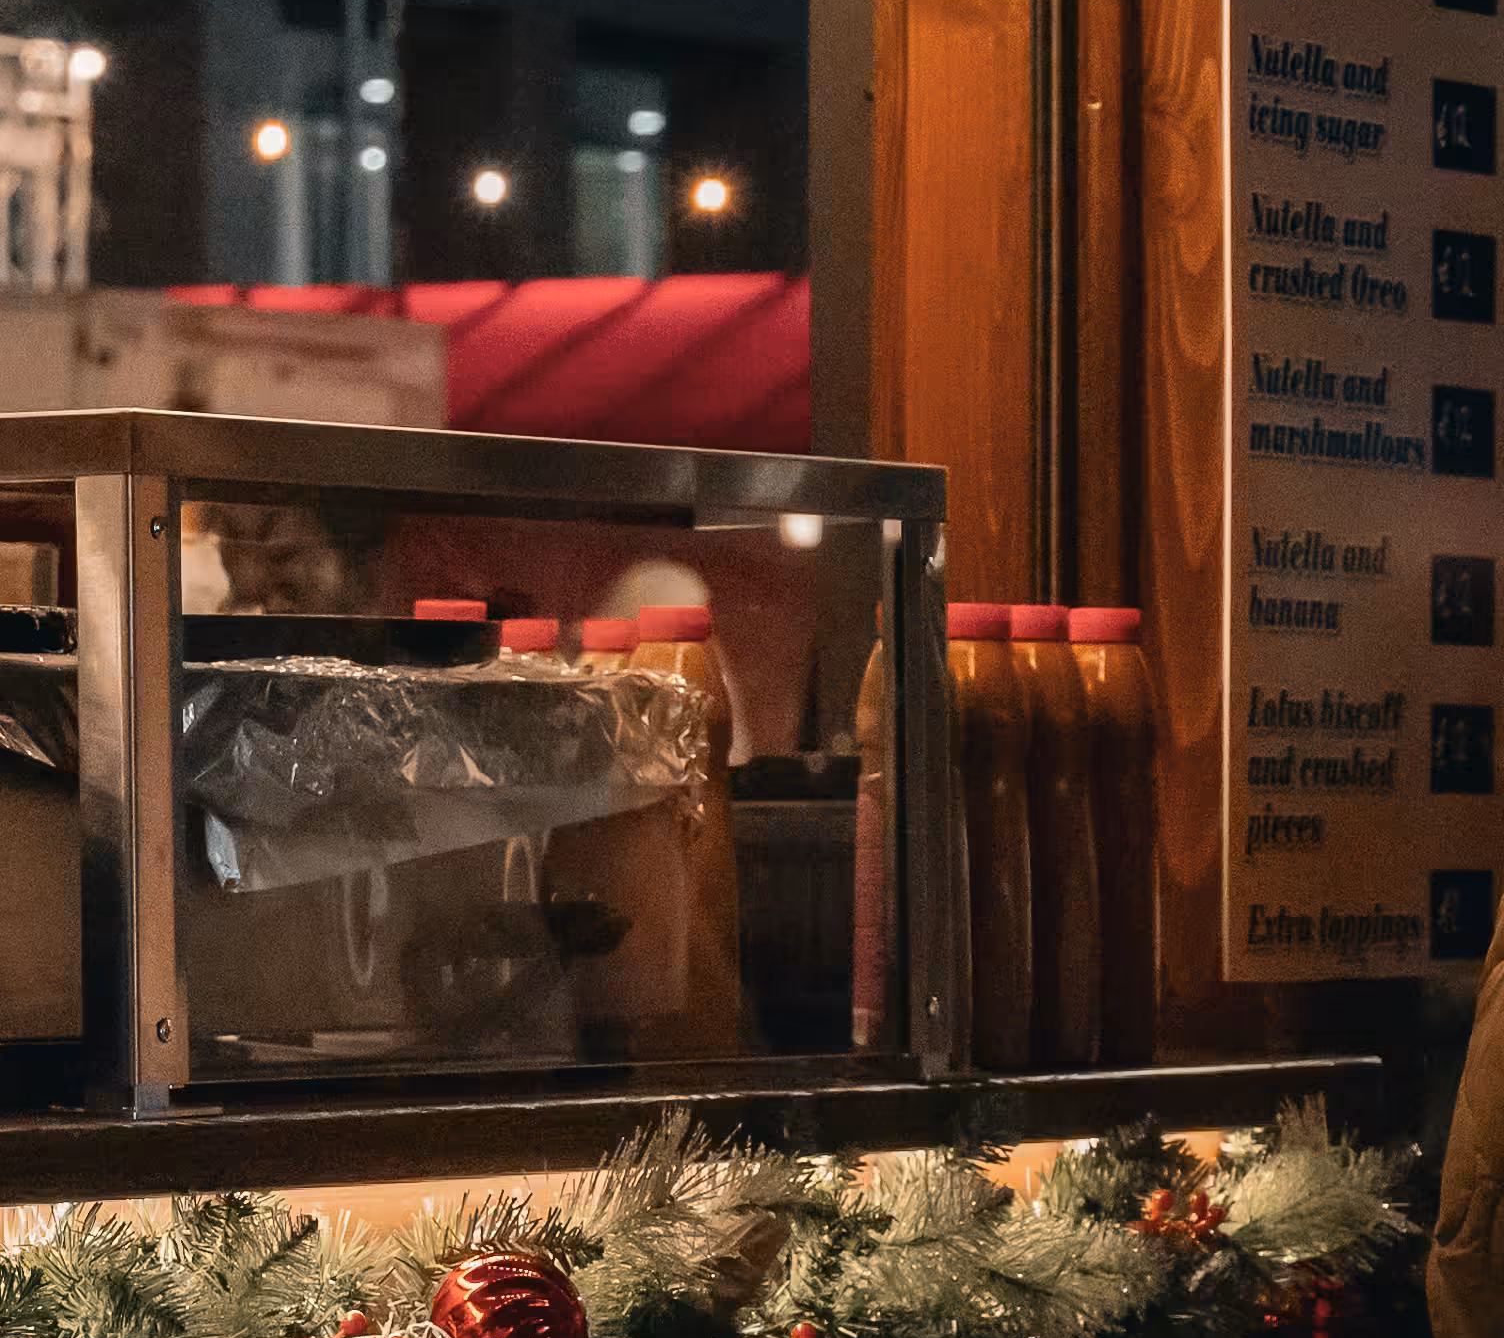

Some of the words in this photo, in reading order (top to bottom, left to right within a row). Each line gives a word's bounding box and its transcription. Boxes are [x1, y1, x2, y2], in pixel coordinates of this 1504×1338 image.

[1250, 35, 1334, 86] Nutella
[1343, 58, 1388, 94] and
[1249, 92, 1310, 155] icing
[1316, 116, 1384, 161] sugar
[1252, 193, 1336, 243] Nutella
[1343, 211, 1388, 249] and
[1249, 259, 1343, 301] crushed
[1351, 263, 1407, 309] Oreo
[1252, 354, 1336, 400] Nutella
[1343, 368, 1387, 406] and
[1250, 418, 1425, 465] marshmallows
[1251, 527, 1335, 572] Nutella
[1343, 536, 1387, 574] and
[1249, 584, 1339, 629] banana
[1248, 687, 1312, 728] Lotus
[1248, 747, 1292, 785] and
[1299, 748, 1393, 788] crushed
[1246, 804, 1322, 857] pieces
[1247, 904, 1312, 945] Extra
